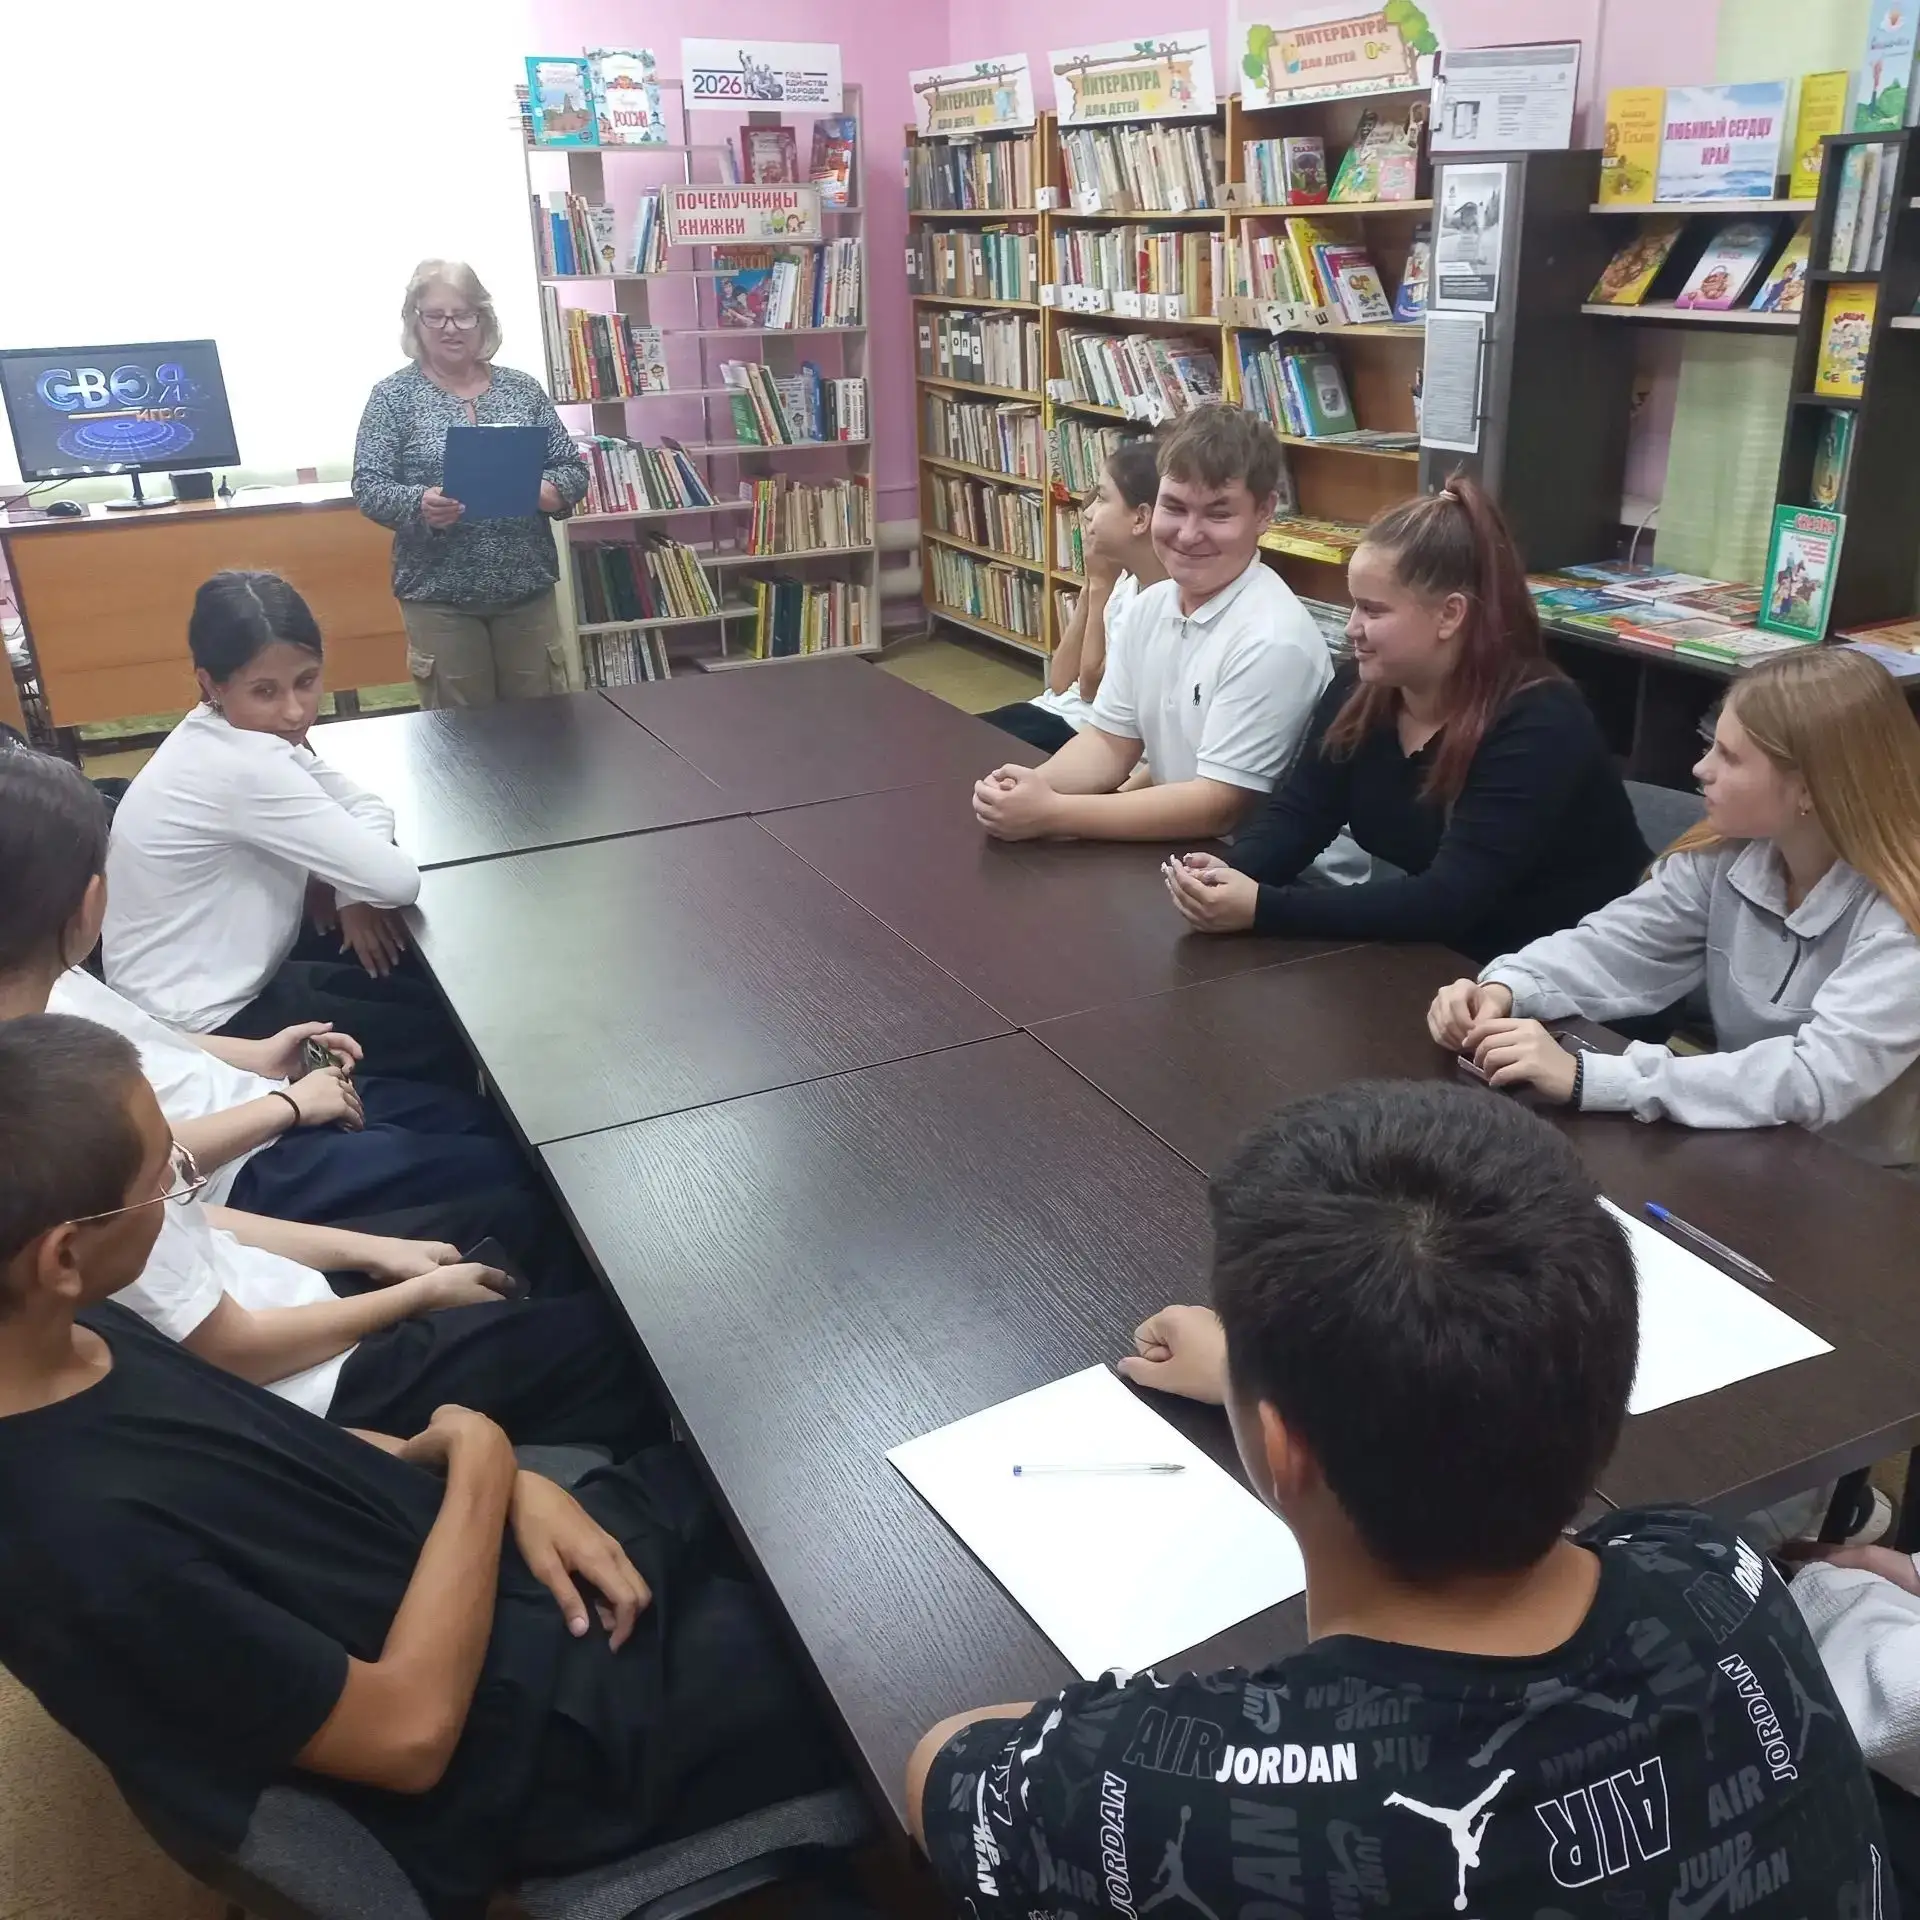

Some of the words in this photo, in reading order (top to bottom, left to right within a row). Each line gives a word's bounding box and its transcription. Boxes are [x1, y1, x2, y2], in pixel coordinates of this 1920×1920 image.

[1294, 16, 1388, 47] ЛИТЕРАТУРА
[692, 74, 742, 94] 2026
[1082, 70, 1161, 96] ЛИТЕРАТУРА
[935, 88, 995, 111] ЛИТЕРАТУРА
[1108, 98, 1140, 116] ДЕТЕЙ
[1665, 116, 1727, 140] ЛЮБИМЫЙ
[1727, 117, 1773, 140] СЕРДЦУ
[1700, 143, 1731, 165] КРАЙ
[675, 191, 798, 210] ПОЧЕМУЧКИНЫ
[678, 218, 745, 235] КНИЖКИ
[1272, 313, 1282, 326] Т
[1314, 311, 1329, 326] Ш
[36, 363, 186, 411] СВОЯ
[1047, 429, 1061, 478] СКАЗКИ
[1717, 1653, 1798, 1781] JORDAN
[1123, 1706, 1224, 1780] AIR
[1215, 1743, 1358, 1785] JORDAN
[1708, 1764, 1765, 1828] AIR
[1535, 1756, 1671, 1888] AIR
[1100, 1770, 1138, 1920] JORDAN
[1678, 1830, 1755, 1898] JUMP
[1726, 1846, 1791, 1914] MAN
